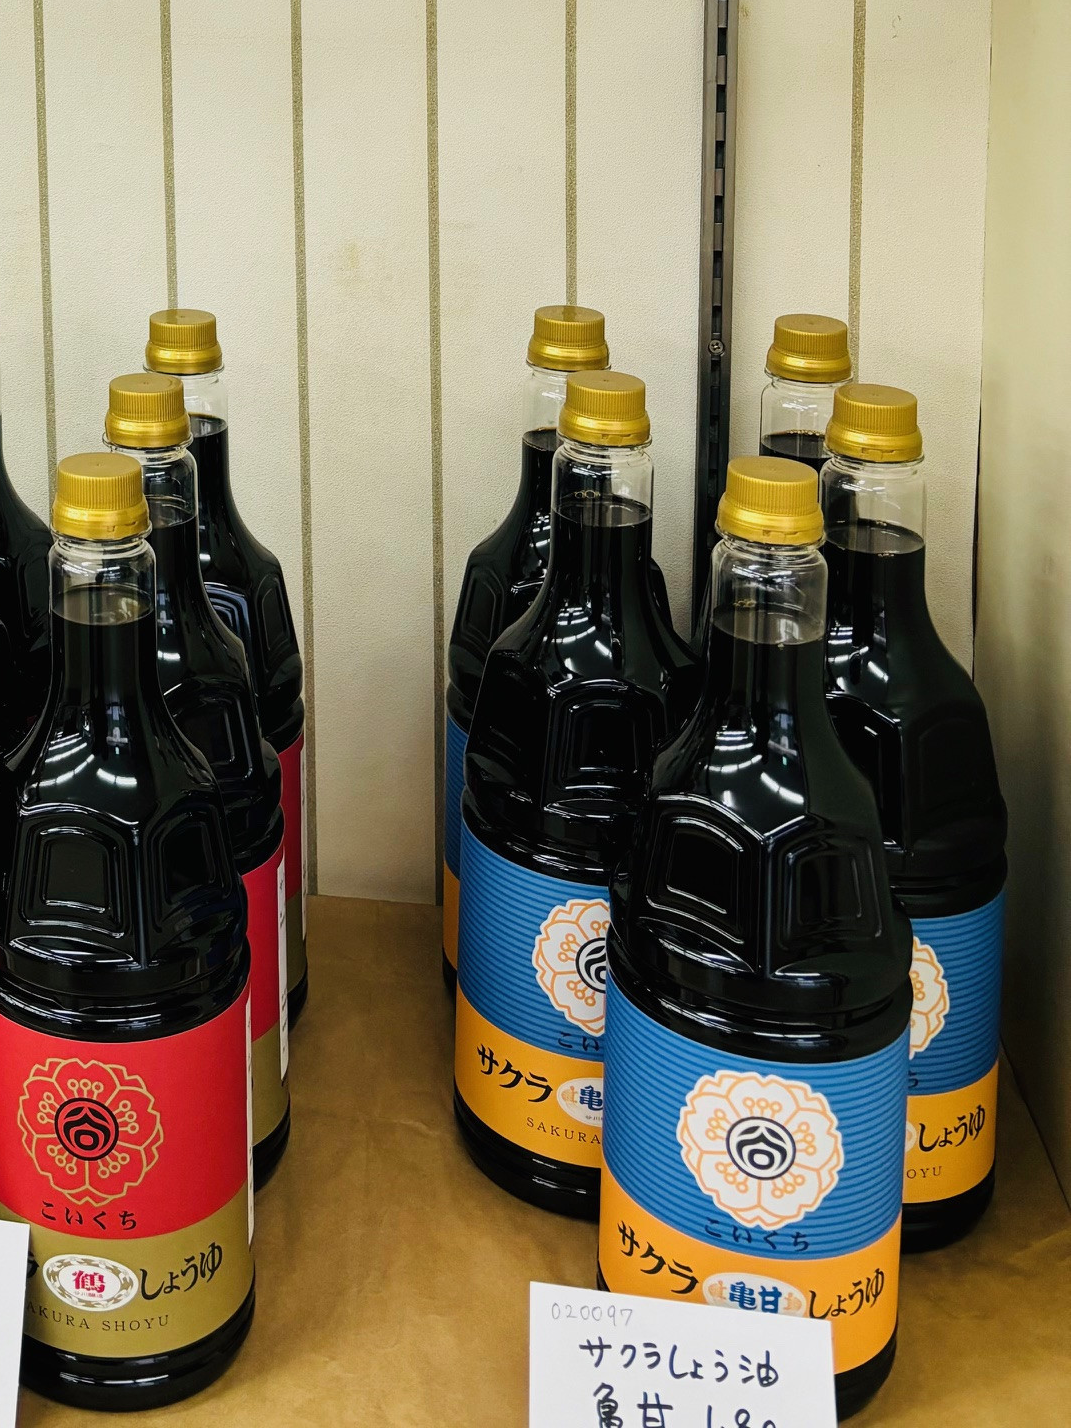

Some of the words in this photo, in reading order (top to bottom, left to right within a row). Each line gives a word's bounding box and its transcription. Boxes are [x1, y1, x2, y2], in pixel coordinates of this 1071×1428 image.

[557, 1032, 600, 1052] こい
[477, 1043, 553, 1103] サクラ
[526, 1117, 602, 1145] SAKURA
[919, 1104, 986, 1153] しょうゆ
[41, 1200, 138, 1231] こいくち
[704, 1216, 811, 1253] こいくち
[140, 1241, 224, 1301] しょうゆ
[617, 1220, 700, 1295] サクラ
[72, 1269, 107, 1293] 鶴
[729, 1280, 783, 1315] 亀甘
[809, 1267, 886, 1320] しょうゆ
[102, 1314, 170, 1333] SHOYU
[551, 1302, 633, 1327] 020097
[579, 1335, 779, 1388] サクラしょう油
